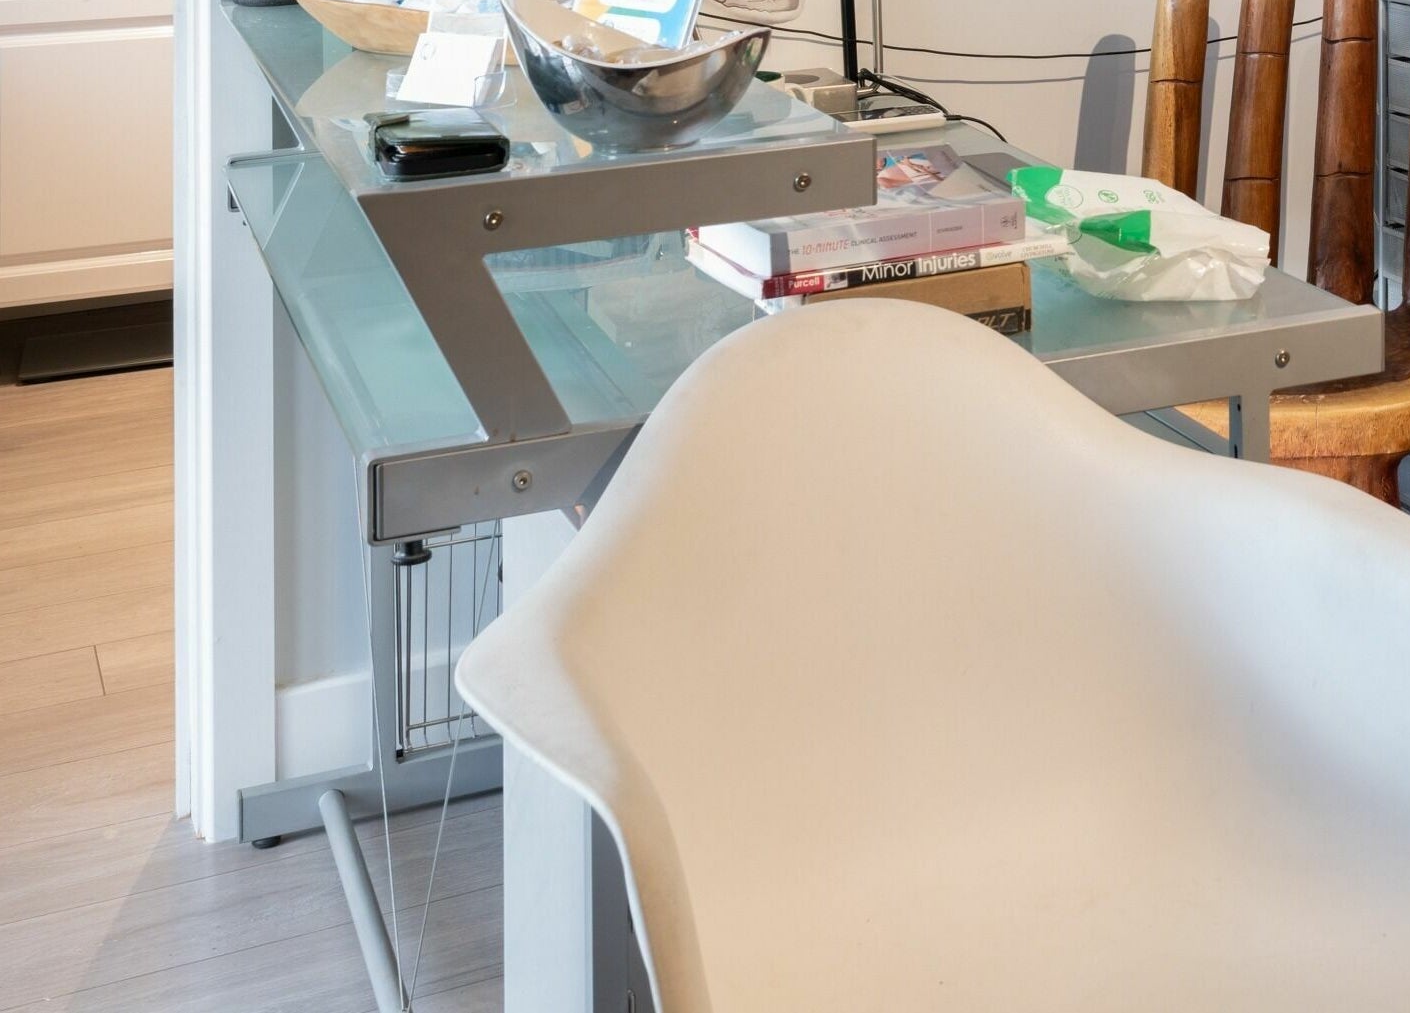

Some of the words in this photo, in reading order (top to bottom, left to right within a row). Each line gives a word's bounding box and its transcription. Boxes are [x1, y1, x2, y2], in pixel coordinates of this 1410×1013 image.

[802, 239, 849, 255] 10-MINUTE
[851, 238, 877, 247] CLINICAL
[879, 231, 918, 243] ASSESSMENT
[861, 260, 914, 282] Minor
[918, 251, 976, 275] Injuries
[788, 277, 820, 289] Purcell
